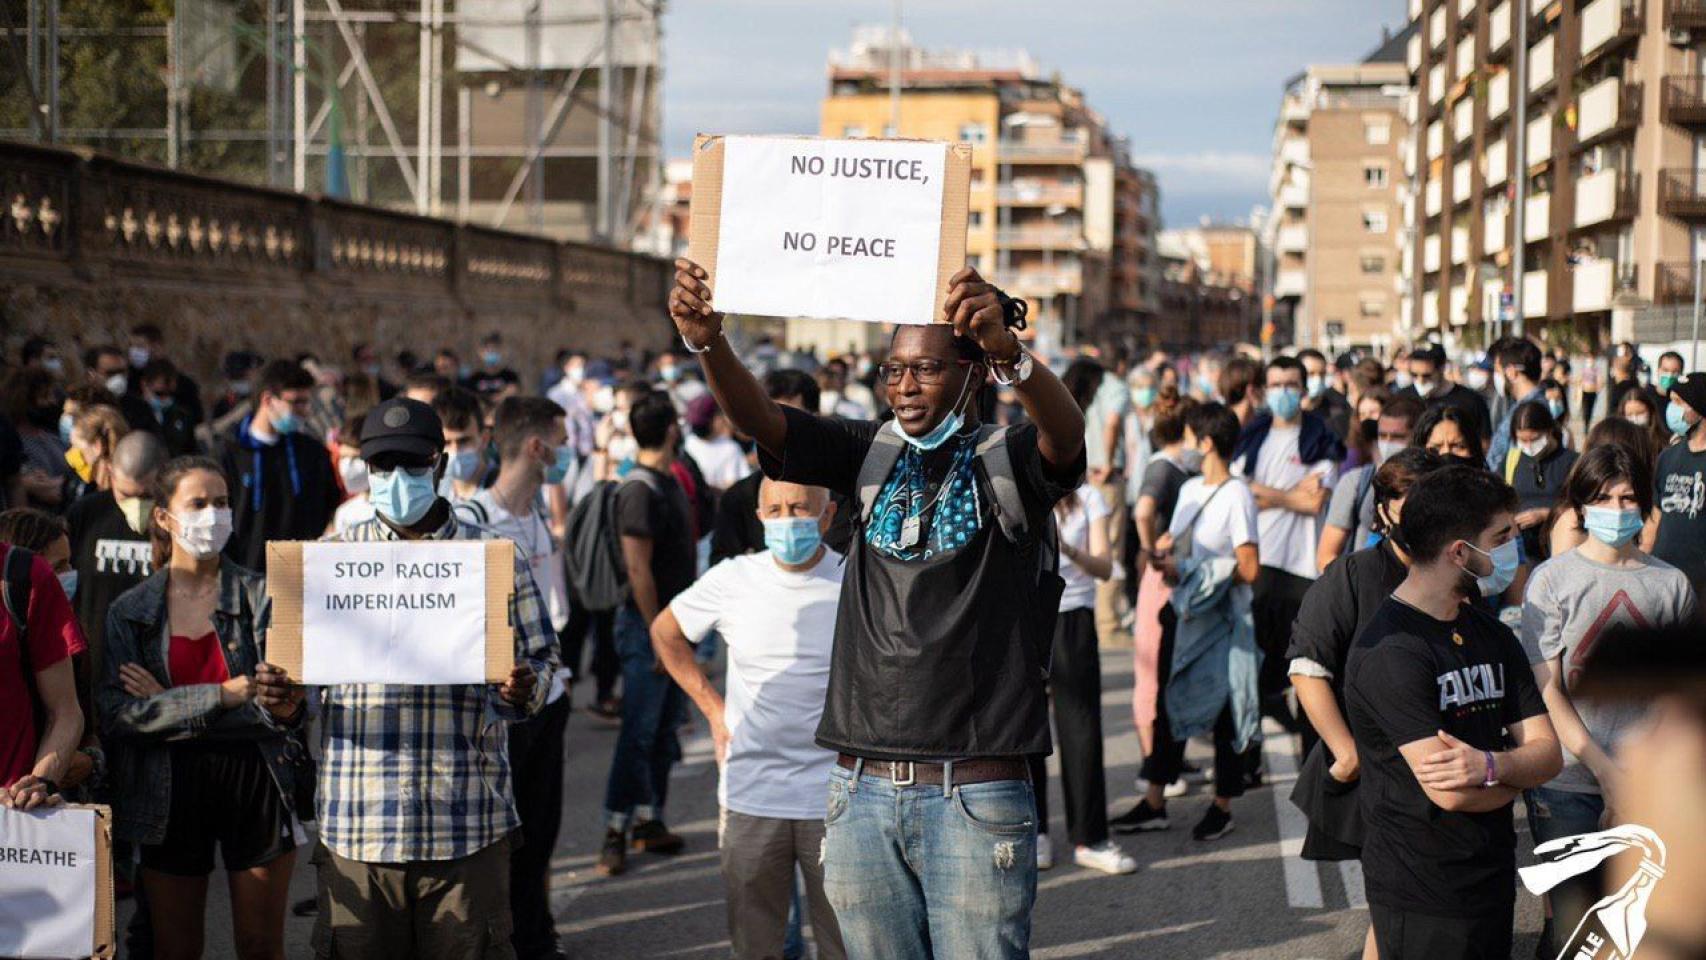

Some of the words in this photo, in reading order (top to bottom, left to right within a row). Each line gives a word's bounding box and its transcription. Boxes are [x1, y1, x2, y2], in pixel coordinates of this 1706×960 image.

[791, 155, 825, 175] NO
[830, 157, 929, 185] JUSTICE,
[783, 231, 817, 252] NO
[827, 236, 896, 258] PEACE
[335, 562, 385, 578] STOP
[396, 562, 463, 578] RACIST
[326, 593, 456, 610] IMPERIALISM
